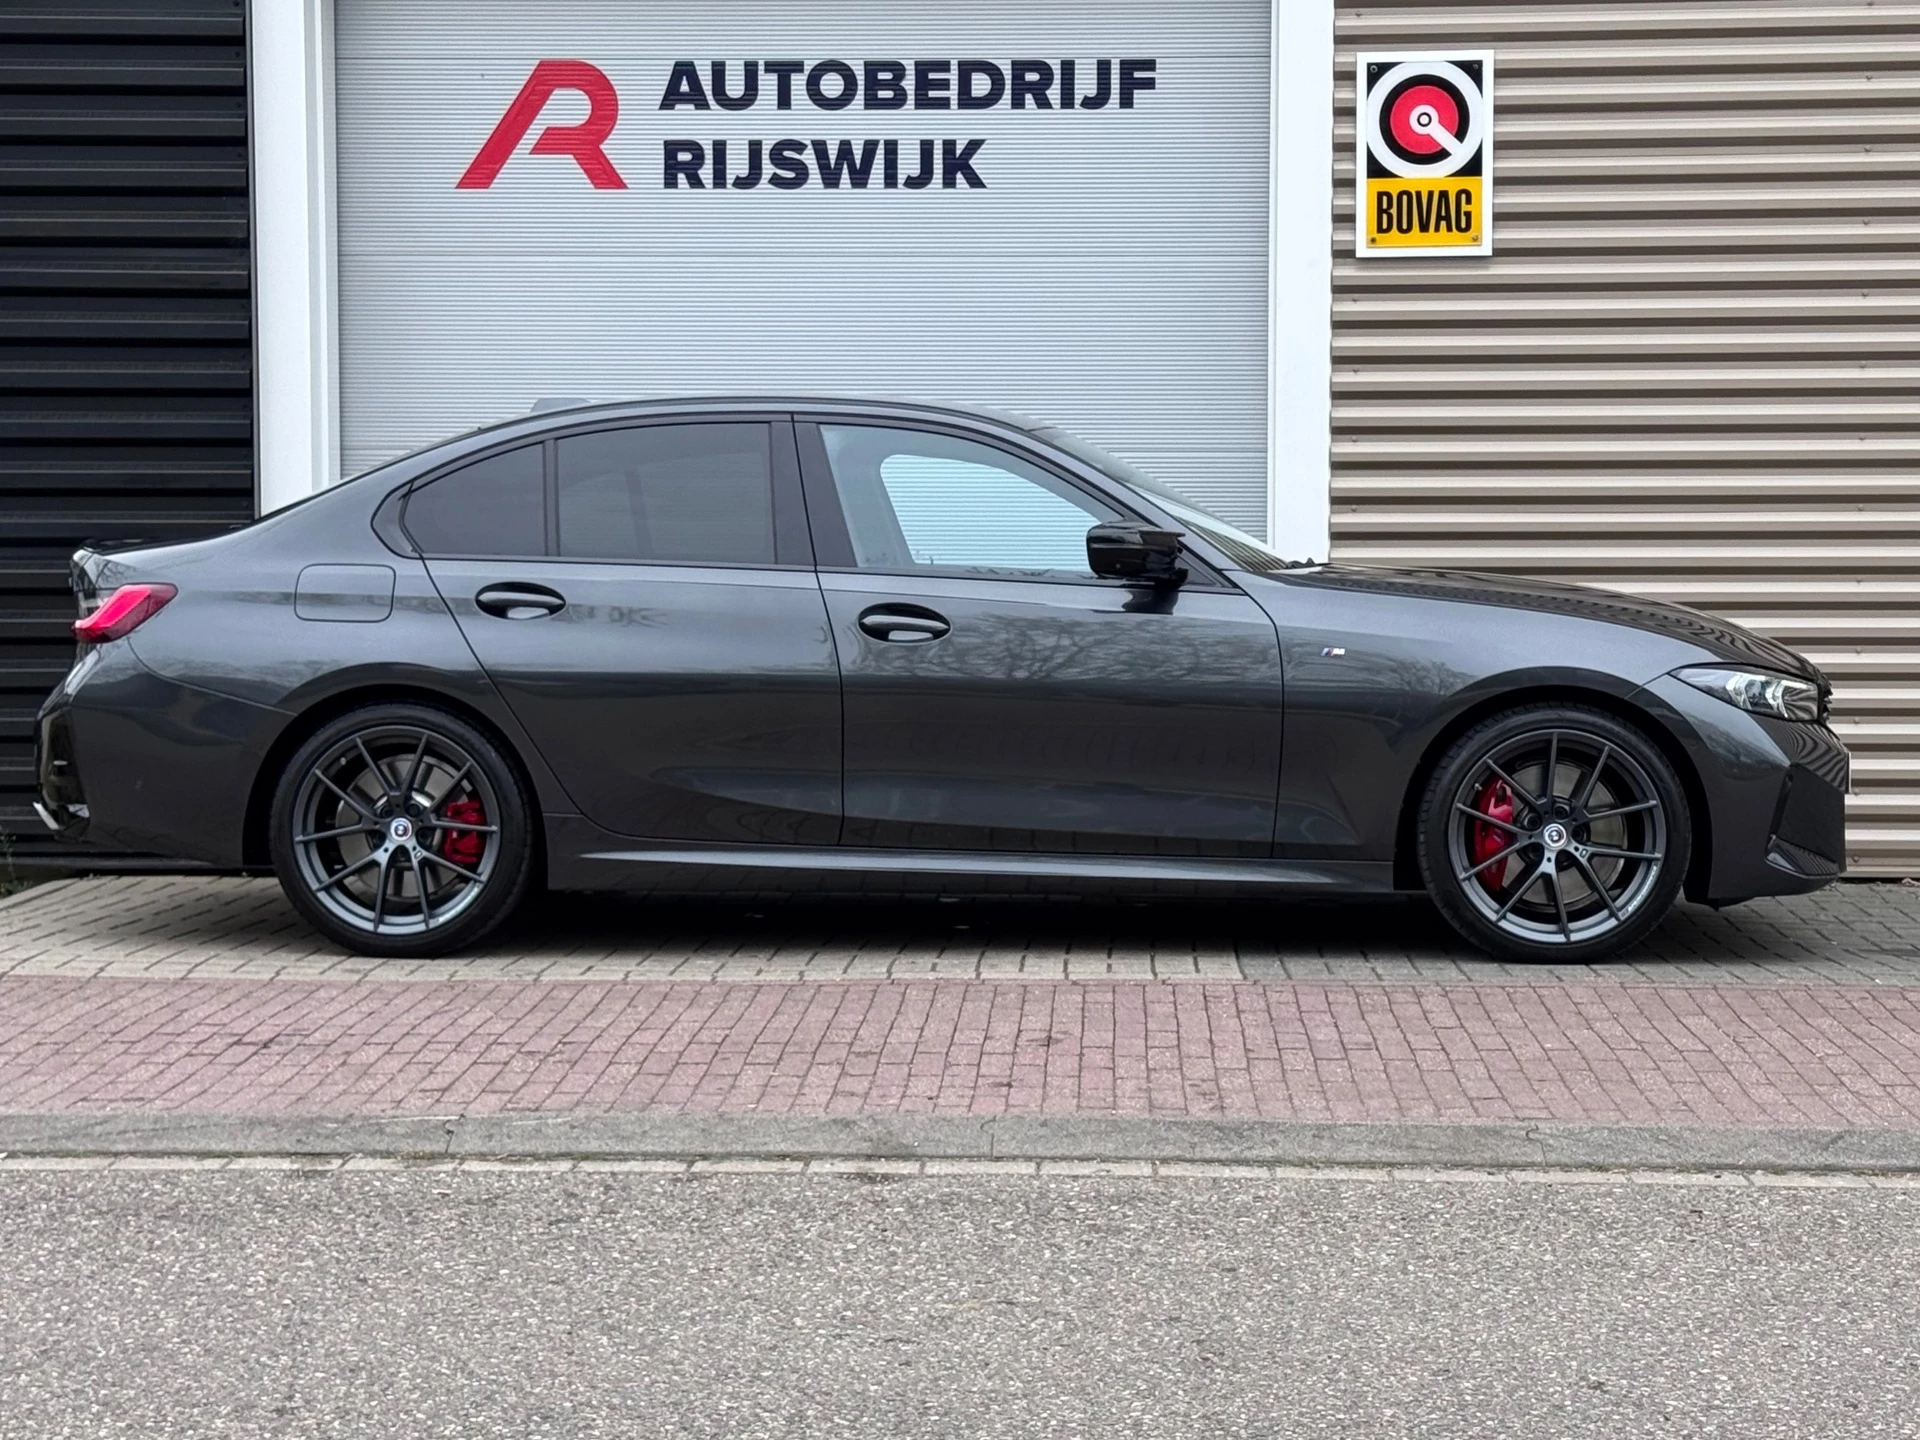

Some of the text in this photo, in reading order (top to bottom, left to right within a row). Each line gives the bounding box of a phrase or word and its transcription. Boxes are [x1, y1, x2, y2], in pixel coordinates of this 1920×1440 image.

[658, 58, 1157, 111] AUTOBEDRIJF
[663, 138, 987, 190] RIJSWIJK
[1376, 188, 1473, 234] BOVAG
